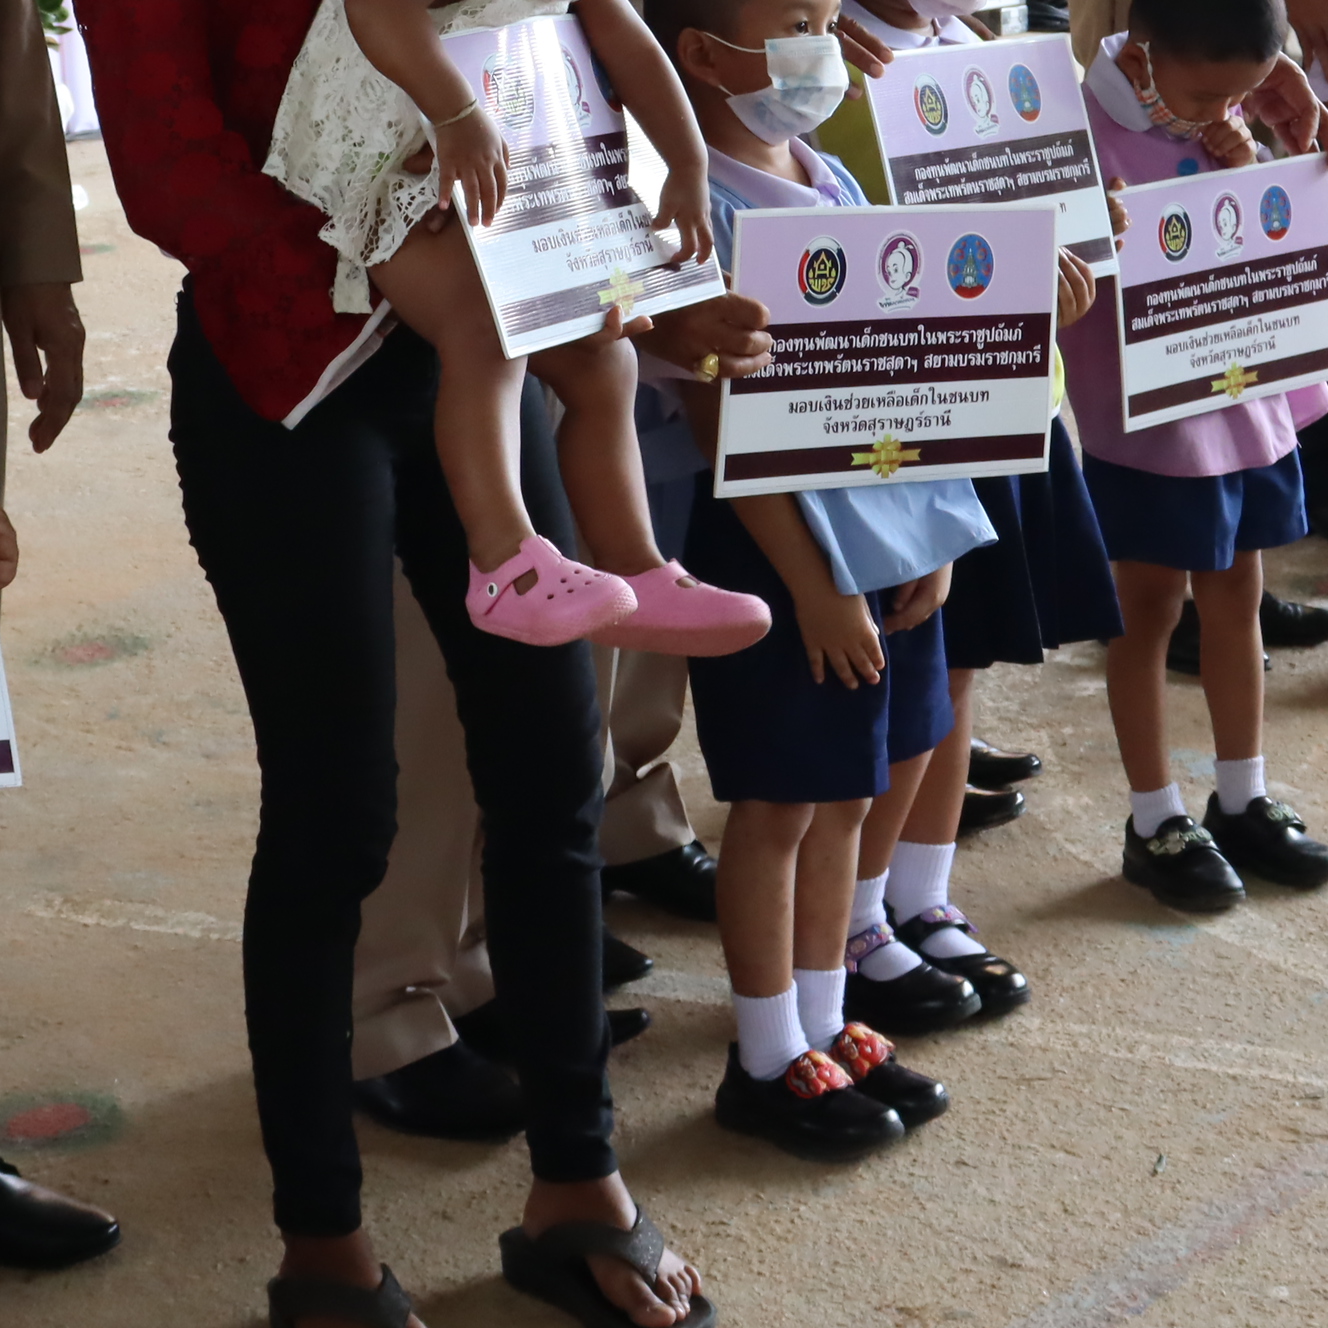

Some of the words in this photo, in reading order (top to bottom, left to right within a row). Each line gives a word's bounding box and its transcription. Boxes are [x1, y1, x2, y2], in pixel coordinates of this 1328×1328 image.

[1165, 315, 1300, 356] มอบเงินช่วยเหลือเด็กในชนบท
[1190, 335, 1276, 369] จังหวัดสุราษฎร์ธานี
[743, 353, 918, 379] เด็จพระเทพรัตนราชสุดาฯ
[924, 344, 1041, 375] สยามบรมราชกุมารี
[788, 386, 990, 415] มอบเงินช่วยเหลือเด็กในชนบท
[822, 409, 952, 437] จังหวัดสุราษฎร์ธานี
